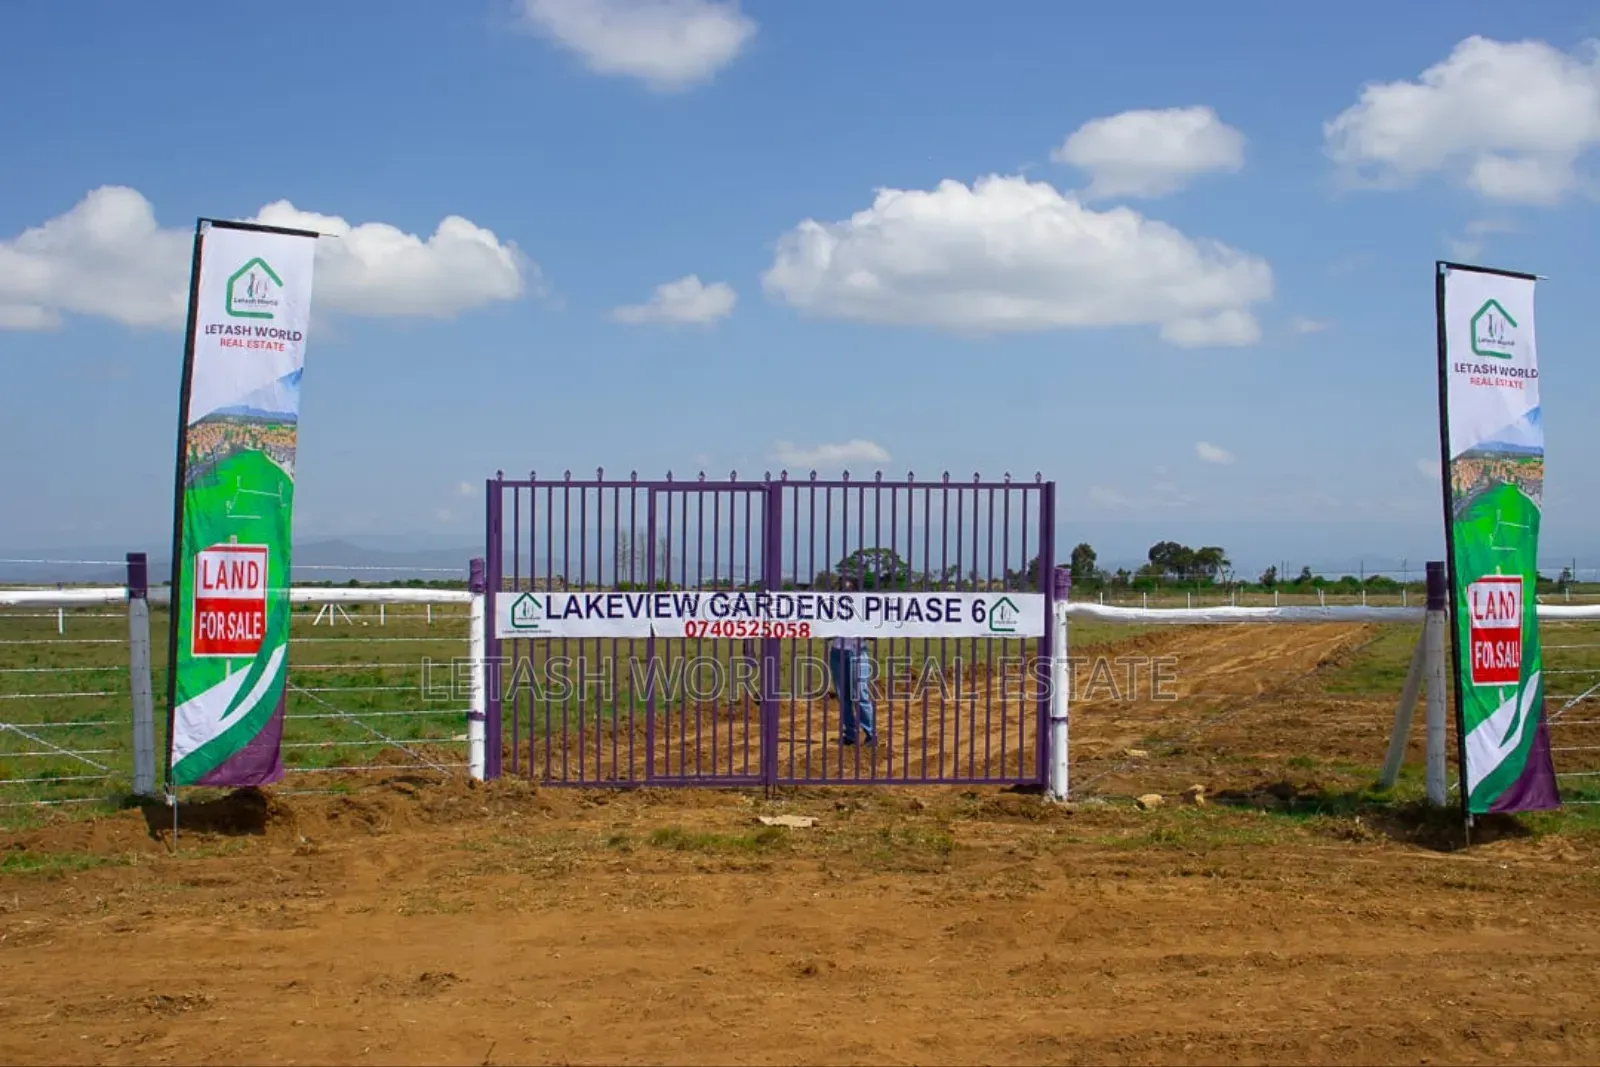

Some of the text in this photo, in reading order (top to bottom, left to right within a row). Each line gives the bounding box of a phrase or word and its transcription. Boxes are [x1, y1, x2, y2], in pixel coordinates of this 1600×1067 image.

[205, 323, 303, 342] LETASH WORLD
[220, 338, 285, 352] REAL ESTATE
[1454, 363, 1539, 379] LETASH WORLD
[1469, 377, 1494, 386] REAL
[203, 559, 259, 590] LAND
[546, 592, 986, 623] LAKEVIEW GARDENS PHASE 6
[199, 611, 262, 640] FOR SALE
[685, 619, 811, 638] 0740525058
